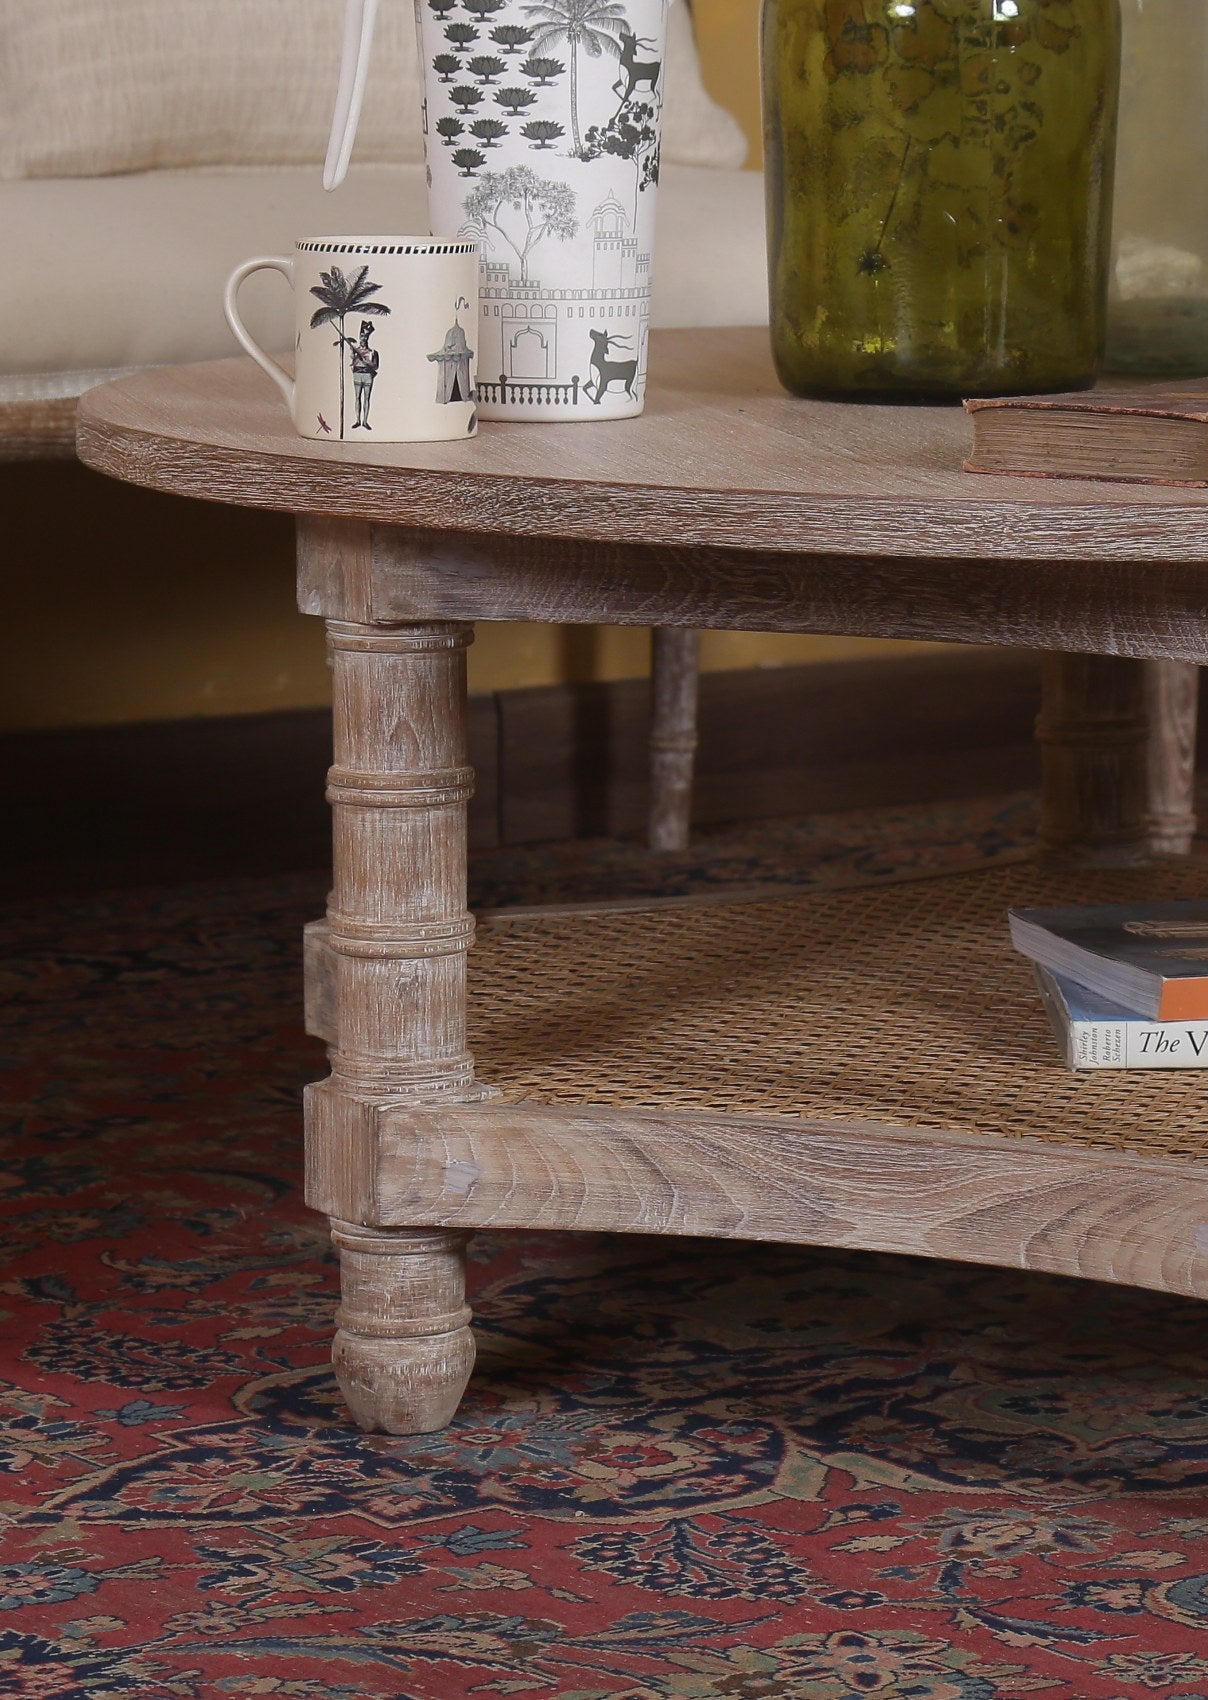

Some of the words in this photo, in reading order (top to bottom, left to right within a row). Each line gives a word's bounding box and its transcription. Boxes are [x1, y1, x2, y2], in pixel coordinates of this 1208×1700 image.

[1079, 1031, 1091, 1061] Shirley
[1089, 1027, 1099, 1066] Johnston
[1102, 1029, 1112, 1062] Roberto
[1112, 1029, 1121, 1062] Schezen
[1139, 1031, 1181, 1054] The
